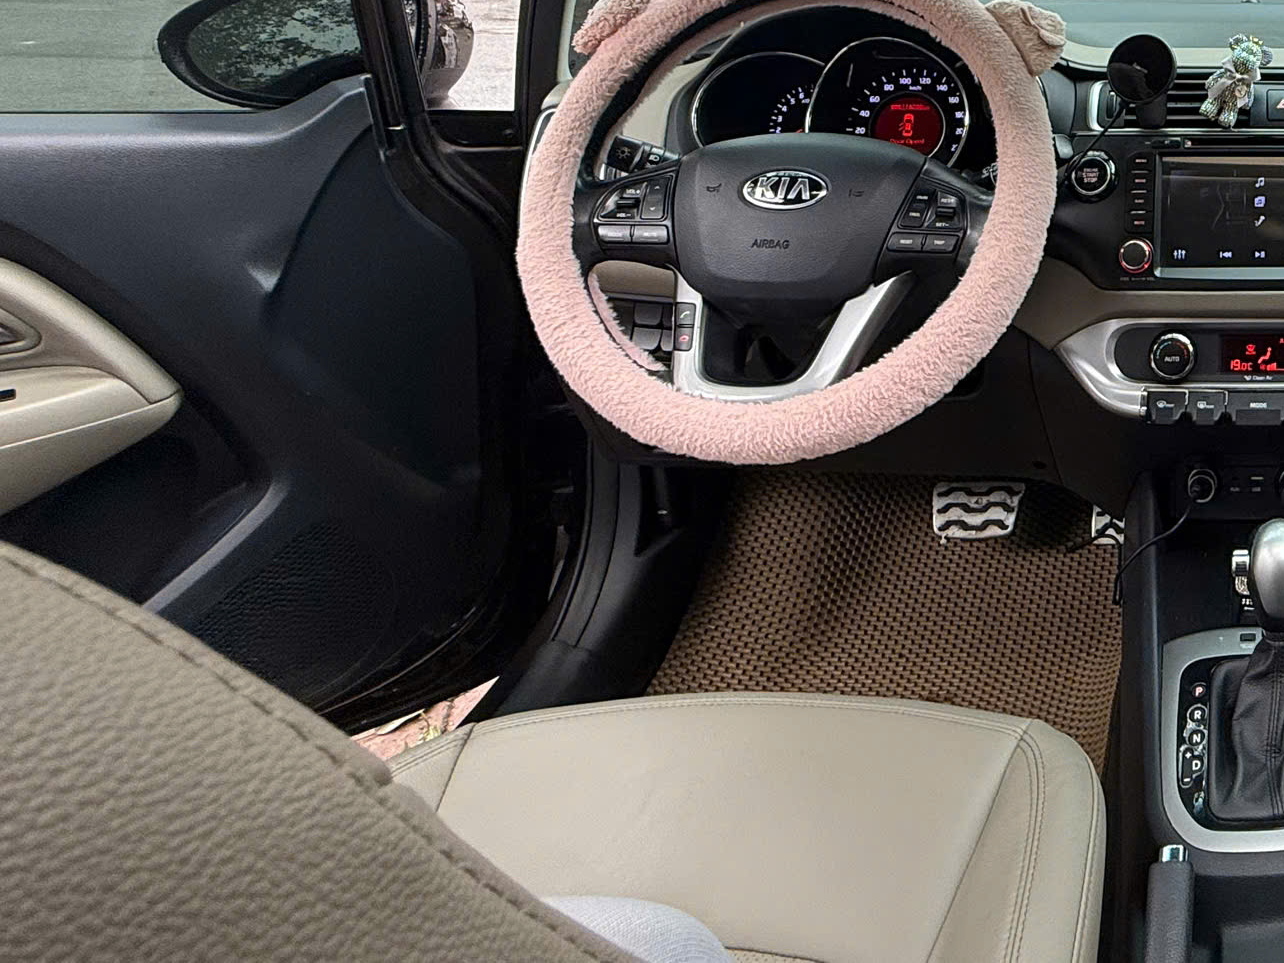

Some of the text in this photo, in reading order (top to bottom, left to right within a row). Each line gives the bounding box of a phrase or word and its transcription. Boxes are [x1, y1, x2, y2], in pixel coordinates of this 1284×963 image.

[899, 77, 912, 85] 100
[919, 77, 932, 85] 120
[869, 95, 880, 103] 60
[859, 110, 870, 118] 40
[754, 176, 811, 201] KIA
[751, 238, 791, 250] AIRBAG
[1164, 355, 1180, 363] AUTO
[1195, 686, 1203, 697] P
[1193, 710, 1202, 720] R
[1192, 734, 1201, 743] N
[1191, 760, 1201, 771] D
